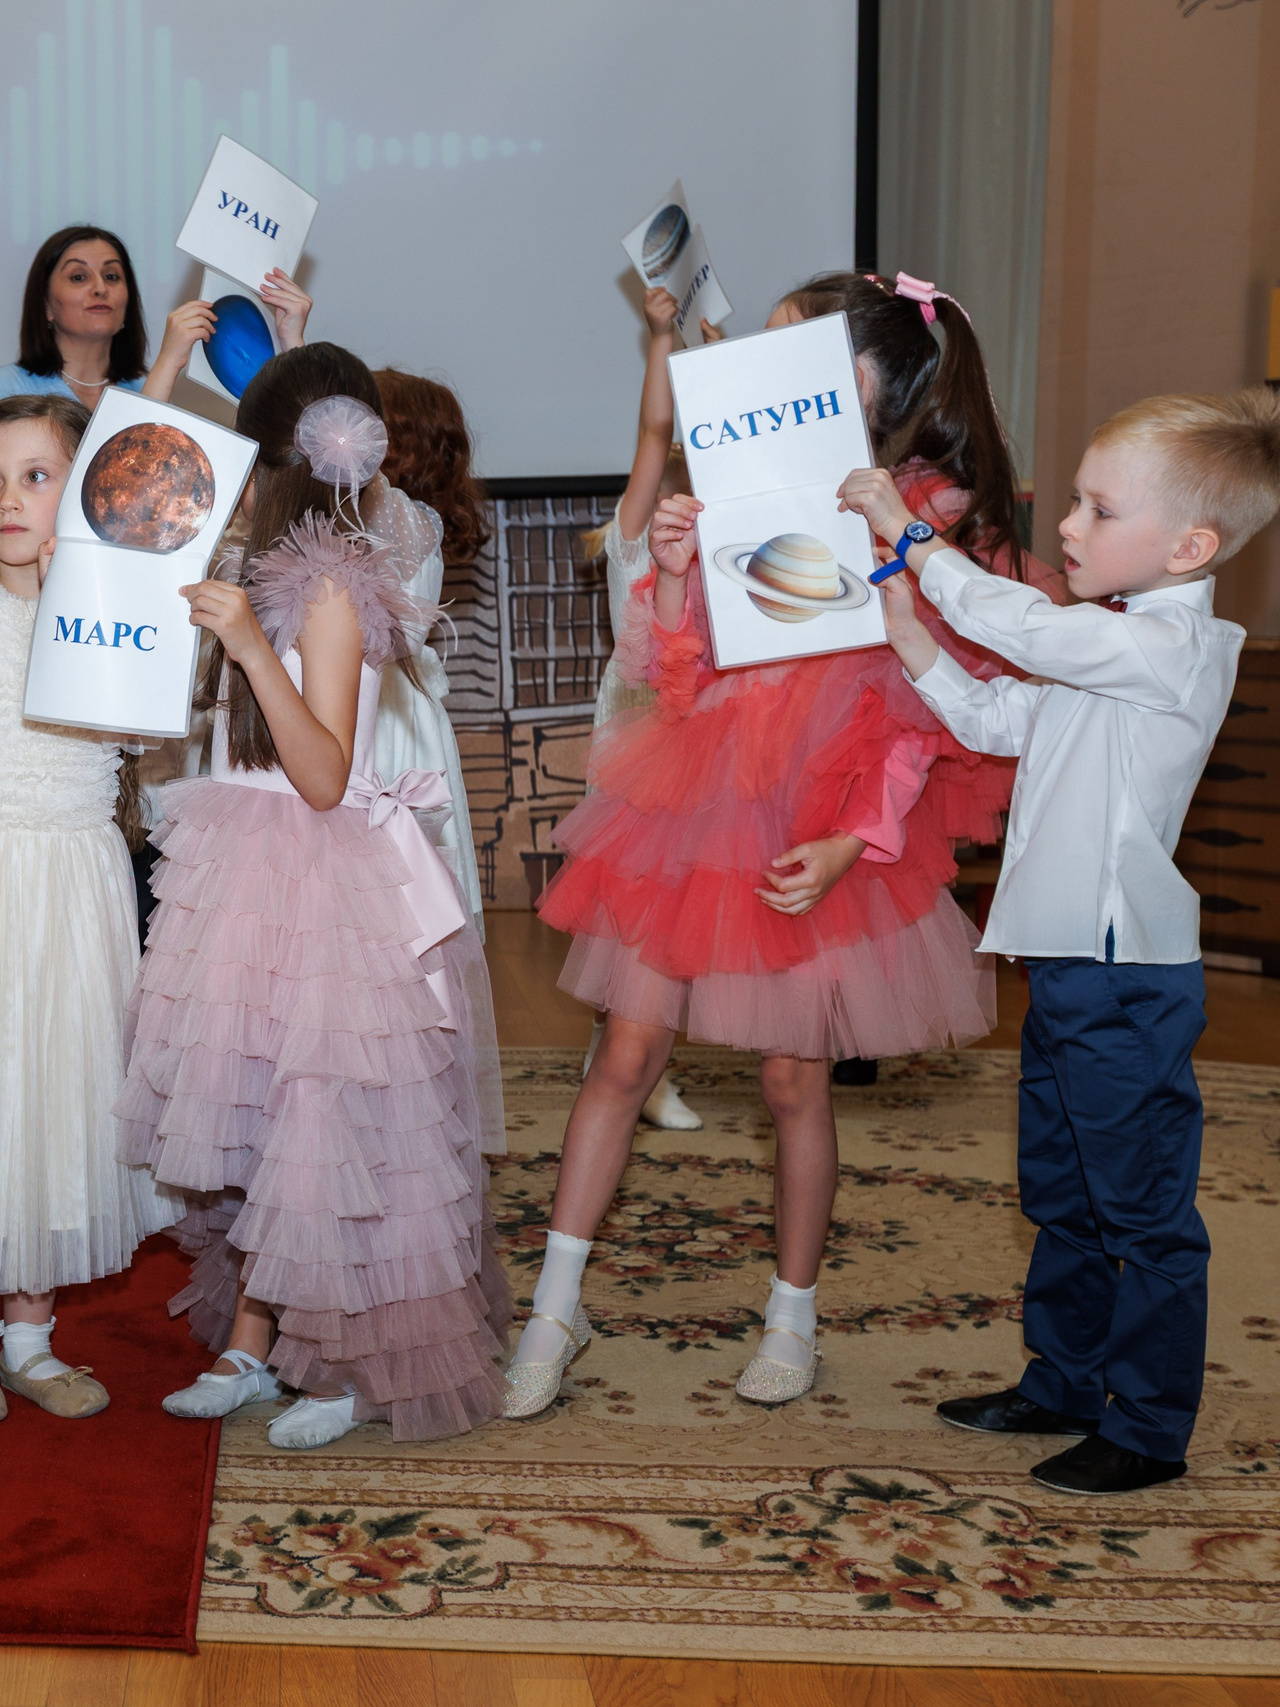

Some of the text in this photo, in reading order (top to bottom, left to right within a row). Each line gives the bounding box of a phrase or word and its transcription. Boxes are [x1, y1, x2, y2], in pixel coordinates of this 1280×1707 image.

[217, 189, 281, 241] УРАН
[689, 388, 844, 450] САТУРН
[52, 615, 158, 652] МАРС
